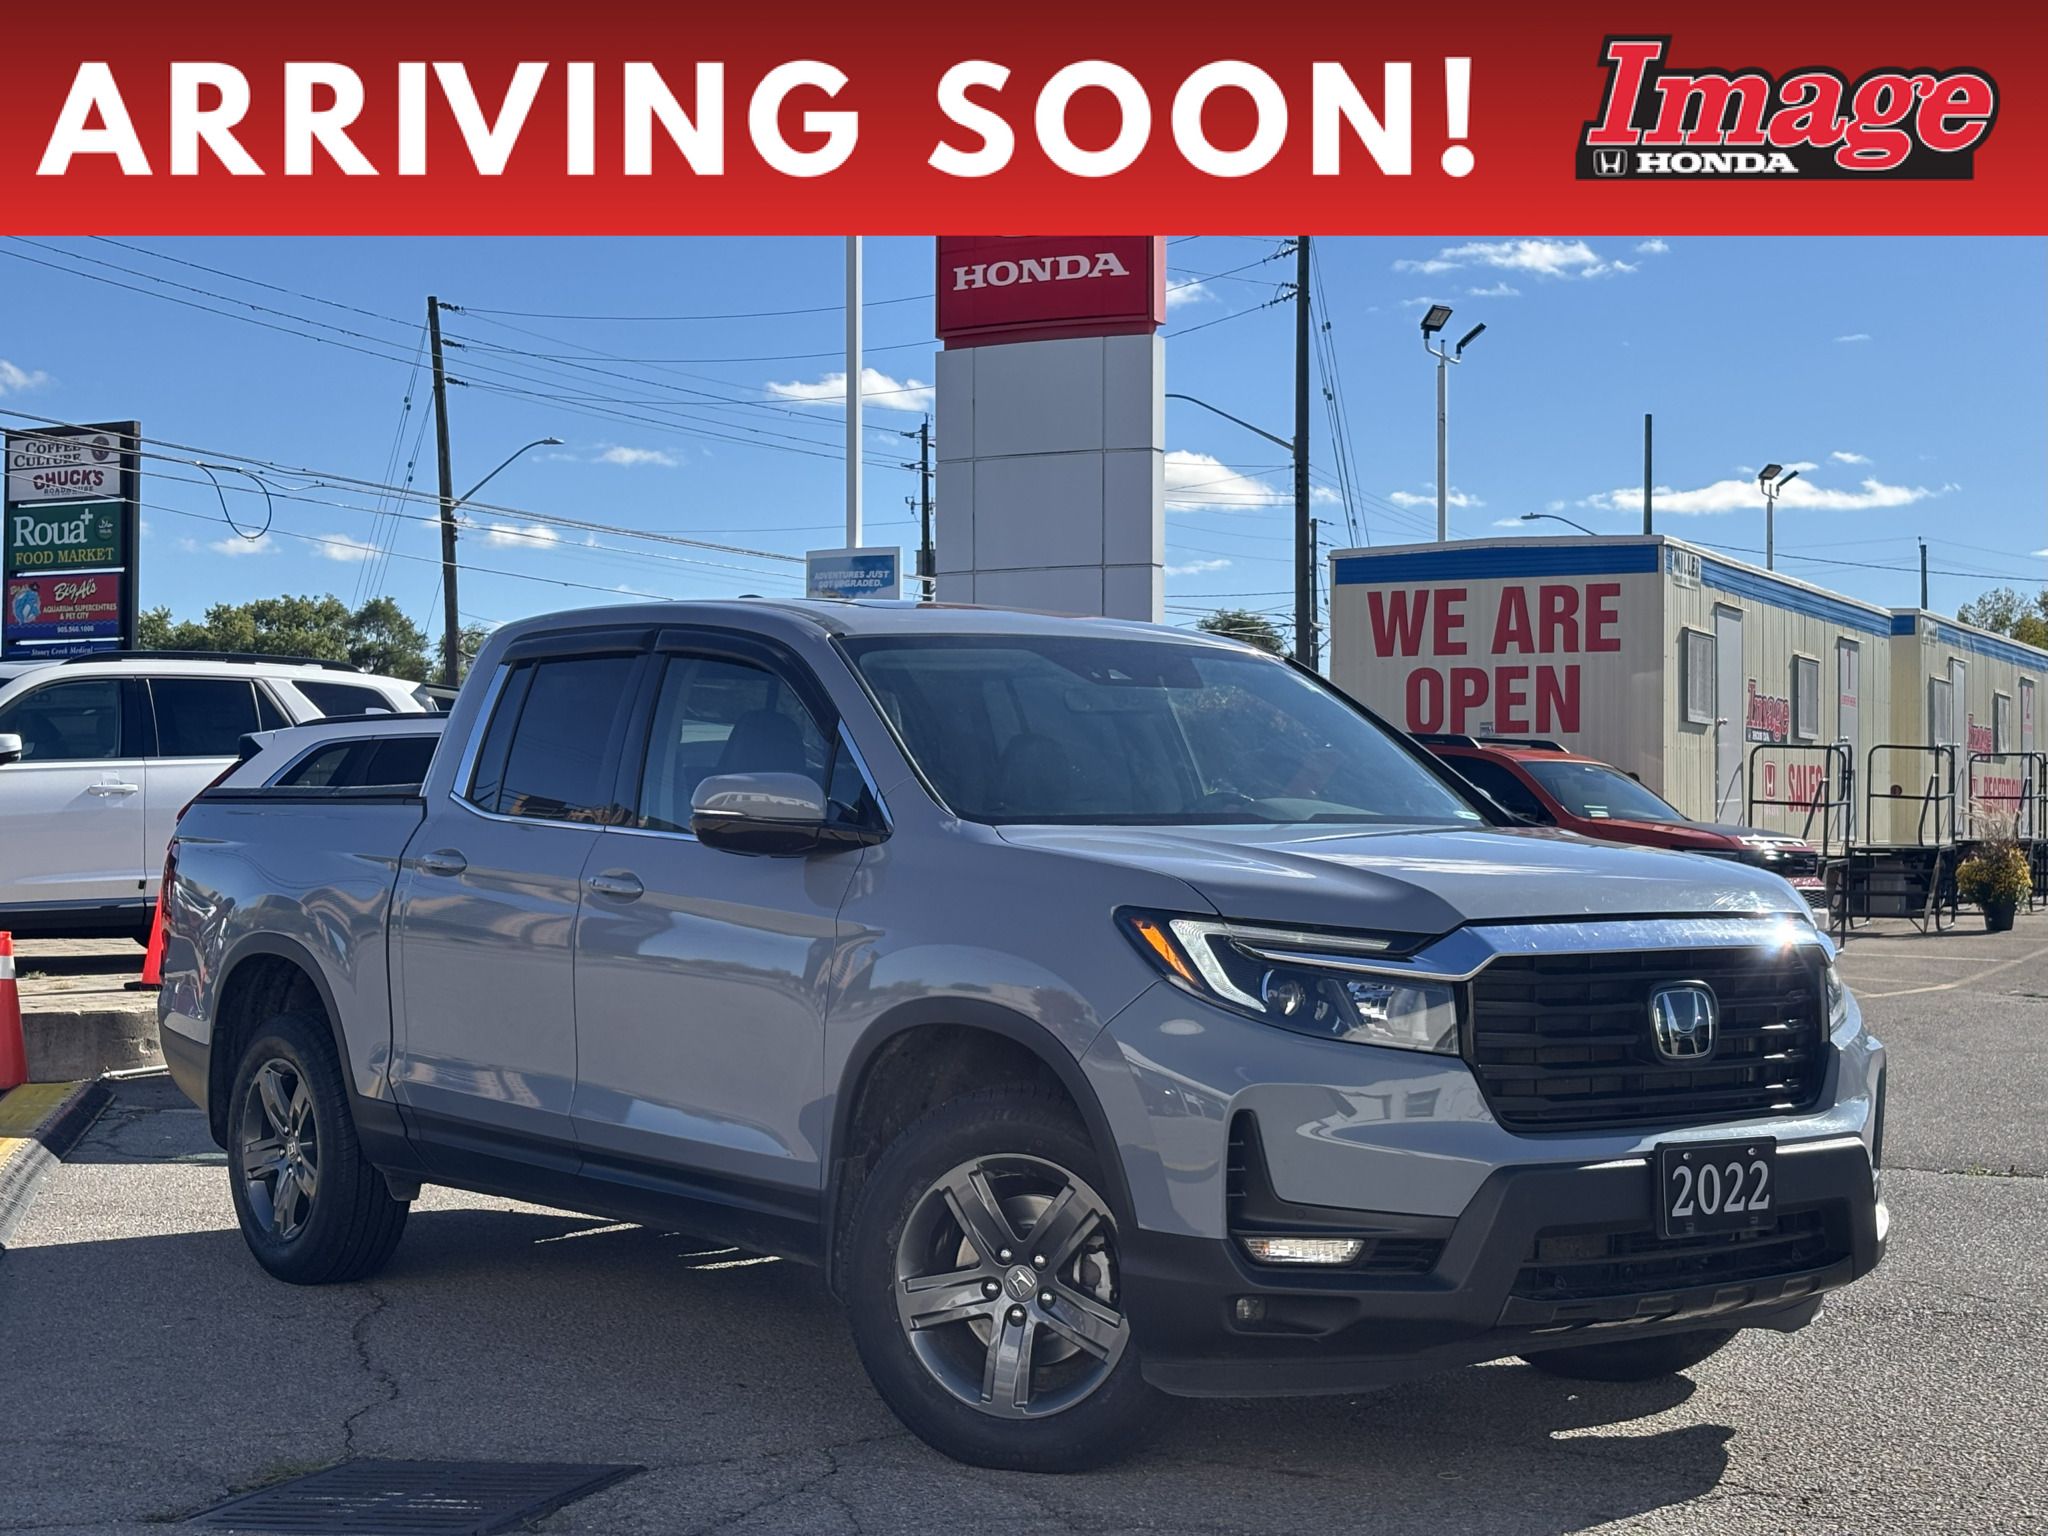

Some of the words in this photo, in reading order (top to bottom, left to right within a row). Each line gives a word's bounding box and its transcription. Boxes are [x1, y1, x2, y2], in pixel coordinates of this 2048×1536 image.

[953, 252, 1129, 291] HONDA
[33, 469, 104, 490] CHUCK'S
[15, 551, 54, 565] FOOD
[57, 547, 115, 563] MARKET
[813, 571, 864, 580] ADVENTURES
[866, 570, 890, 578] JUST
[1367, 588, 1467, 657] WE
[1491, 583, 1621, 655] ARE
[1405, 665, 1581, 734] OPEN
[1788, 763, 1824, 813] SALES
[1671, 1160, 1770, 1217] 2022
